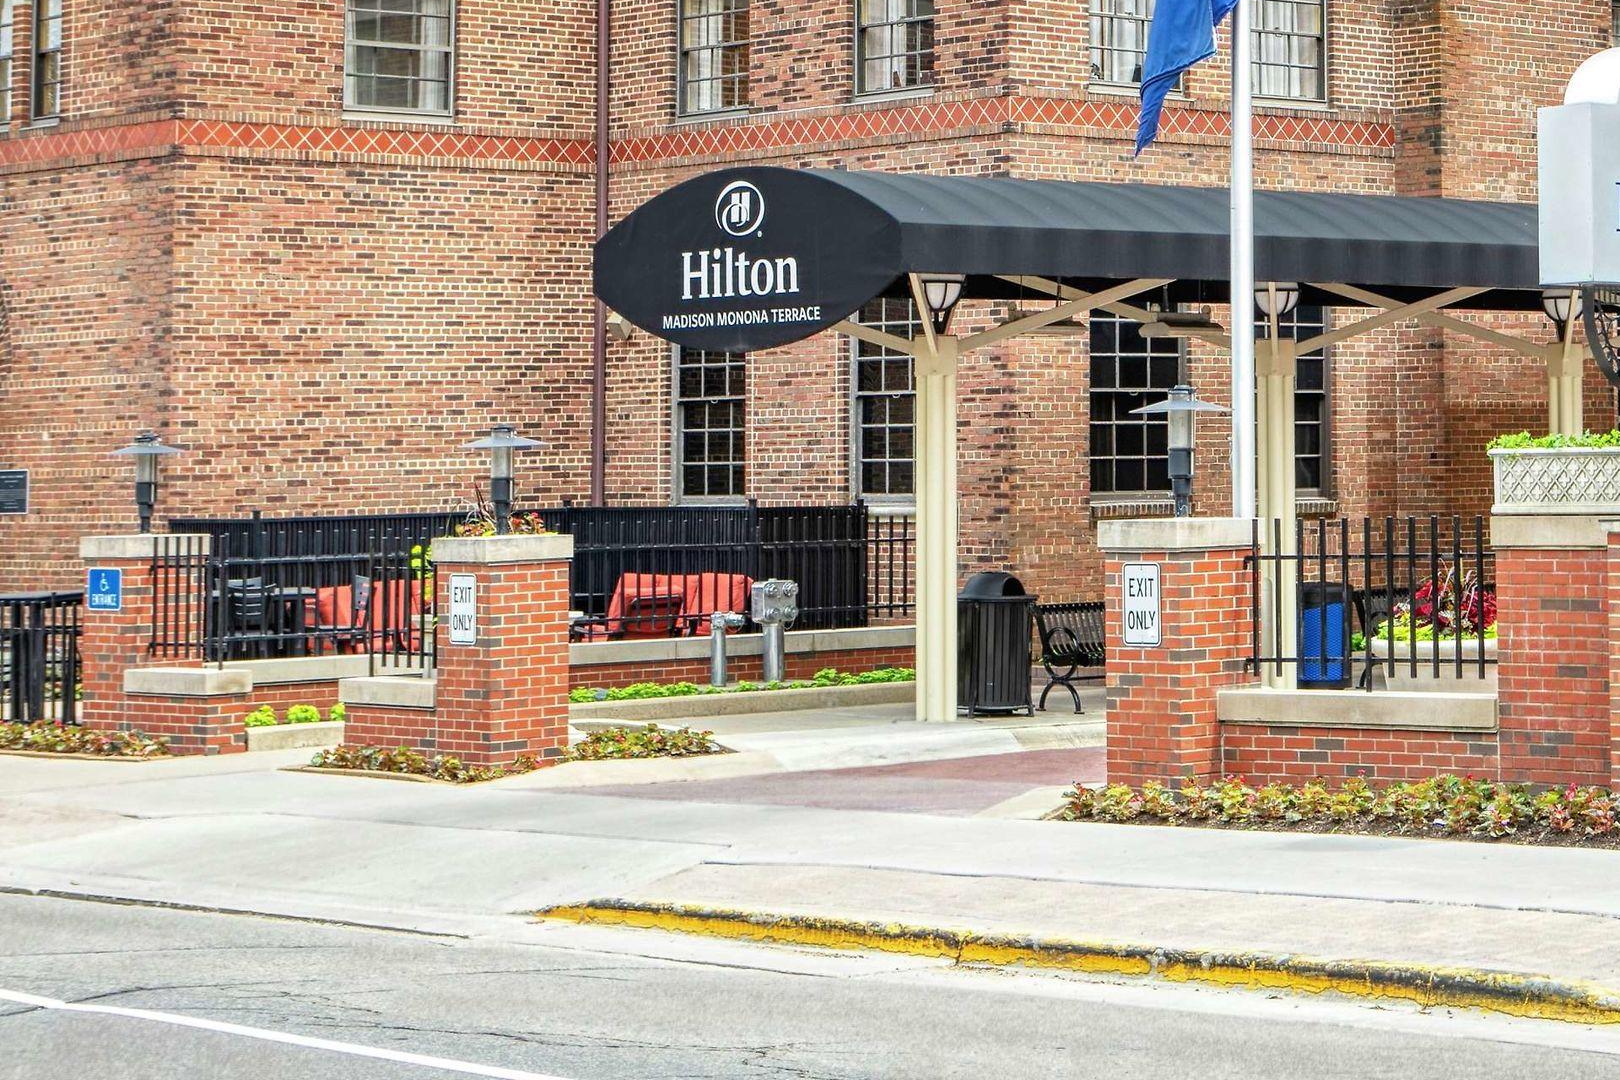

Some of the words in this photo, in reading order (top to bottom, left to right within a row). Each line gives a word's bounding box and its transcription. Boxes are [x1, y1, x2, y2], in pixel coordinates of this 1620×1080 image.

[681, 247, 800, 300] Hilton
[662, 312, 714, 330] MADISON
[717, 309, 769, 326] MONONA
[770, 306, 821, 323] TERRACE
[453, 586, 472, 603] EXIT
[1128, 577, 1154, 598] EXIT
[452, 614, 473, 631] ONLY
[1127, 610, 1156, 630] ONLY
